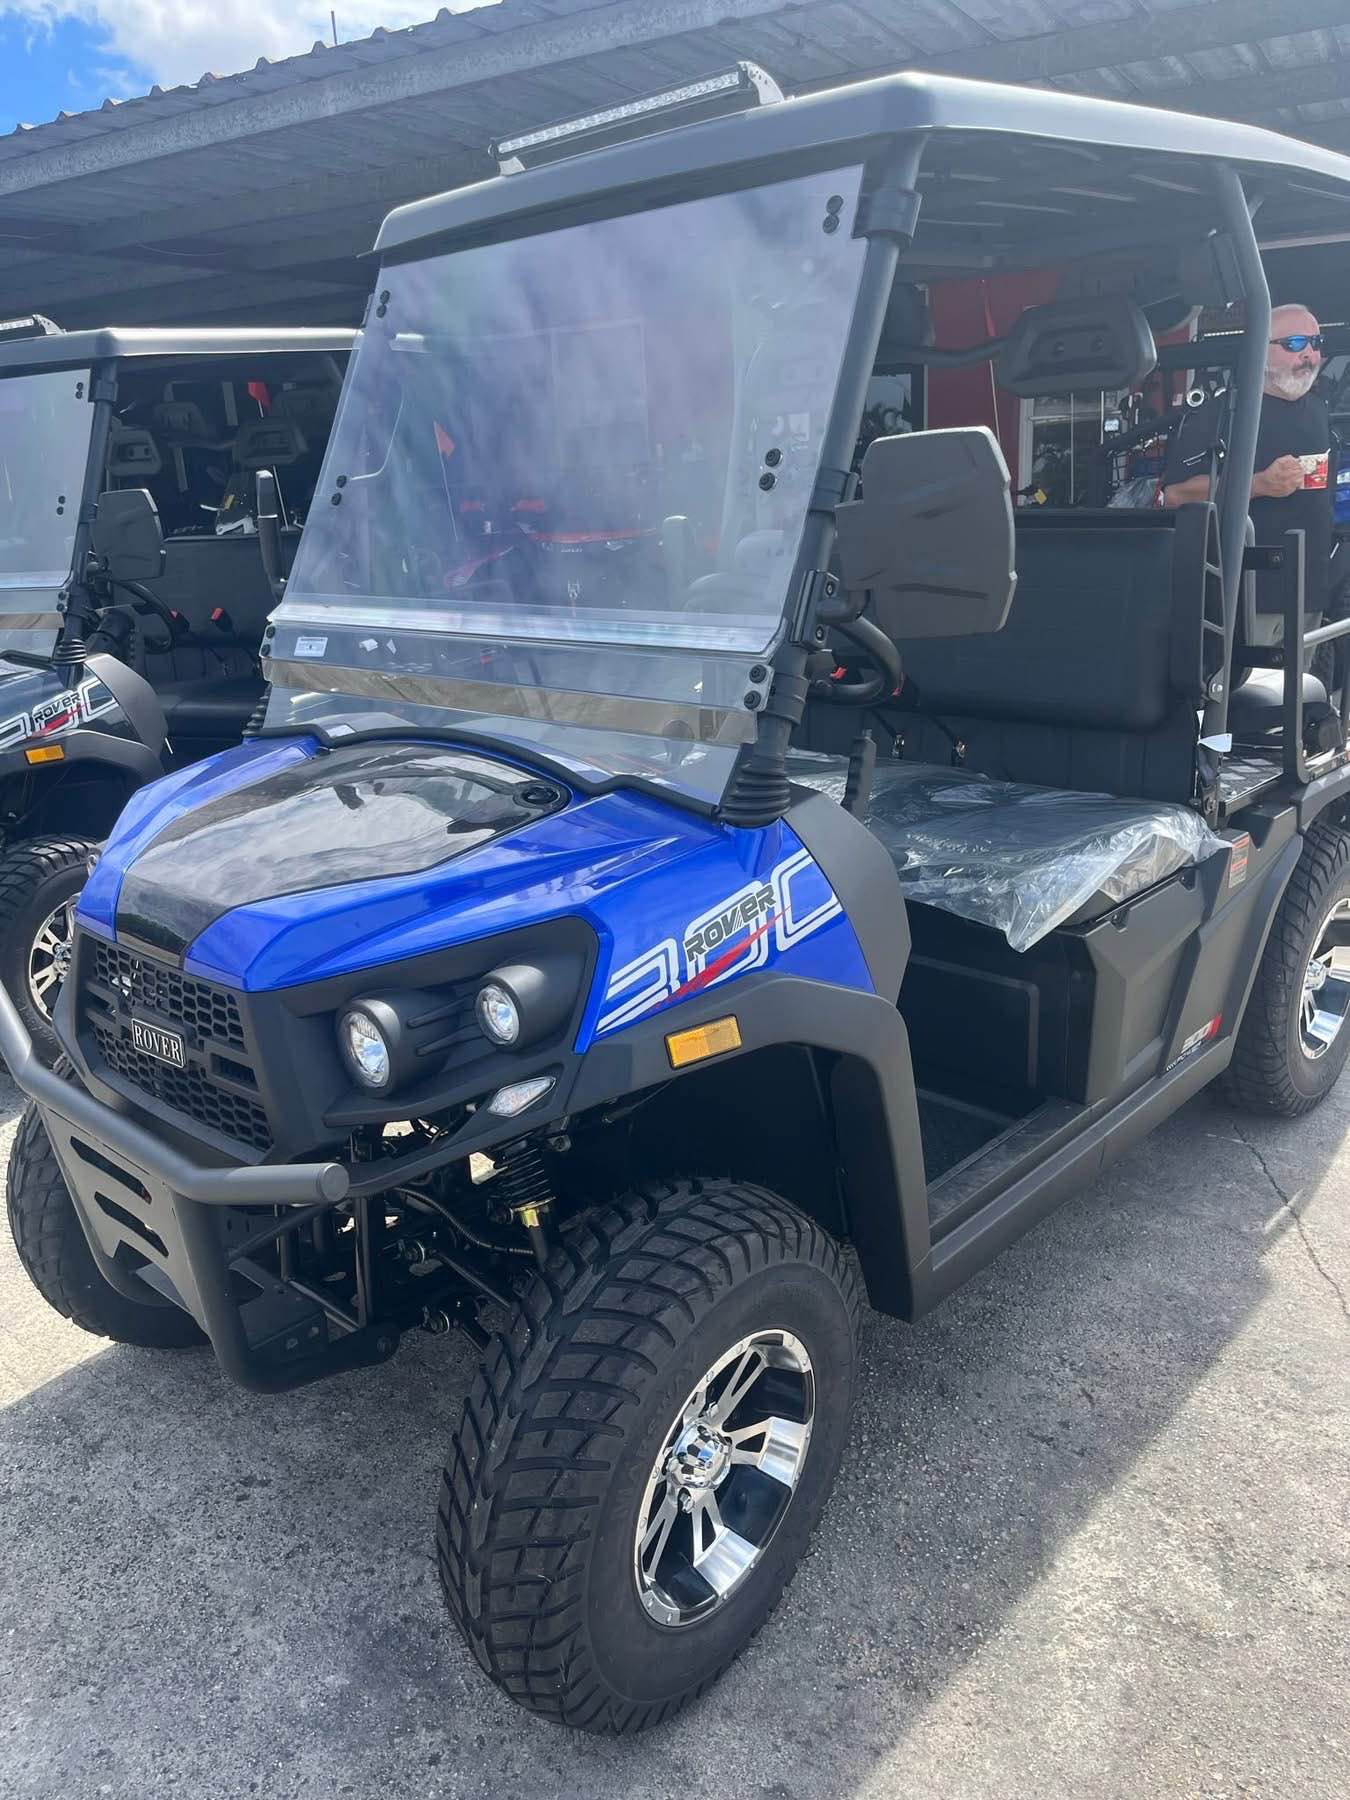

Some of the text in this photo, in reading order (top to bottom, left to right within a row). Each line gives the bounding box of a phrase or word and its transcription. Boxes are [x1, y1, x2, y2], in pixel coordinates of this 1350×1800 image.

[33, 692, 81, 723] ROVER
[685, 885, 777, 963] ROVER
[134, 1024, 181, 1063] ROVER
